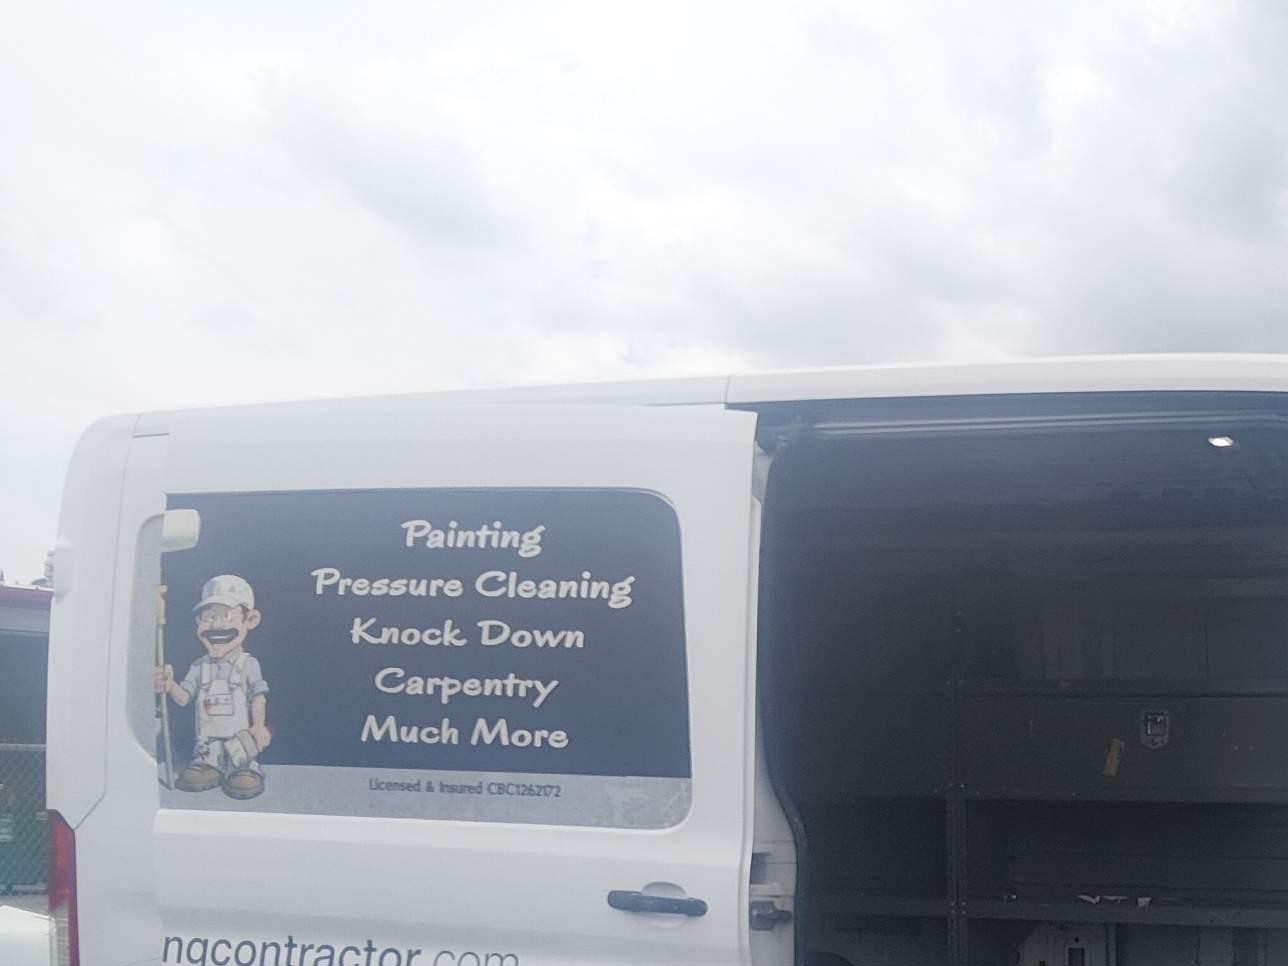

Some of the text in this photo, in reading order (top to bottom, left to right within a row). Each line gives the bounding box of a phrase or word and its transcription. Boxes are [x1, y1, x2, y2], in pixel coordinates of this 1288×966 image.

[401, 519, 545, 558] Painting
[311, 567, 636, 609] Pressure Cleaning
[350, 616, 585, 648] Knock Down
[375, 666, 559, 708] Carpentry
[361, 714, 569, 748] Much More
[369, 778, 422, 792] Licensed
[426, 781, 435, 793] &
[487, 782, 562, 798] CBC1262172
